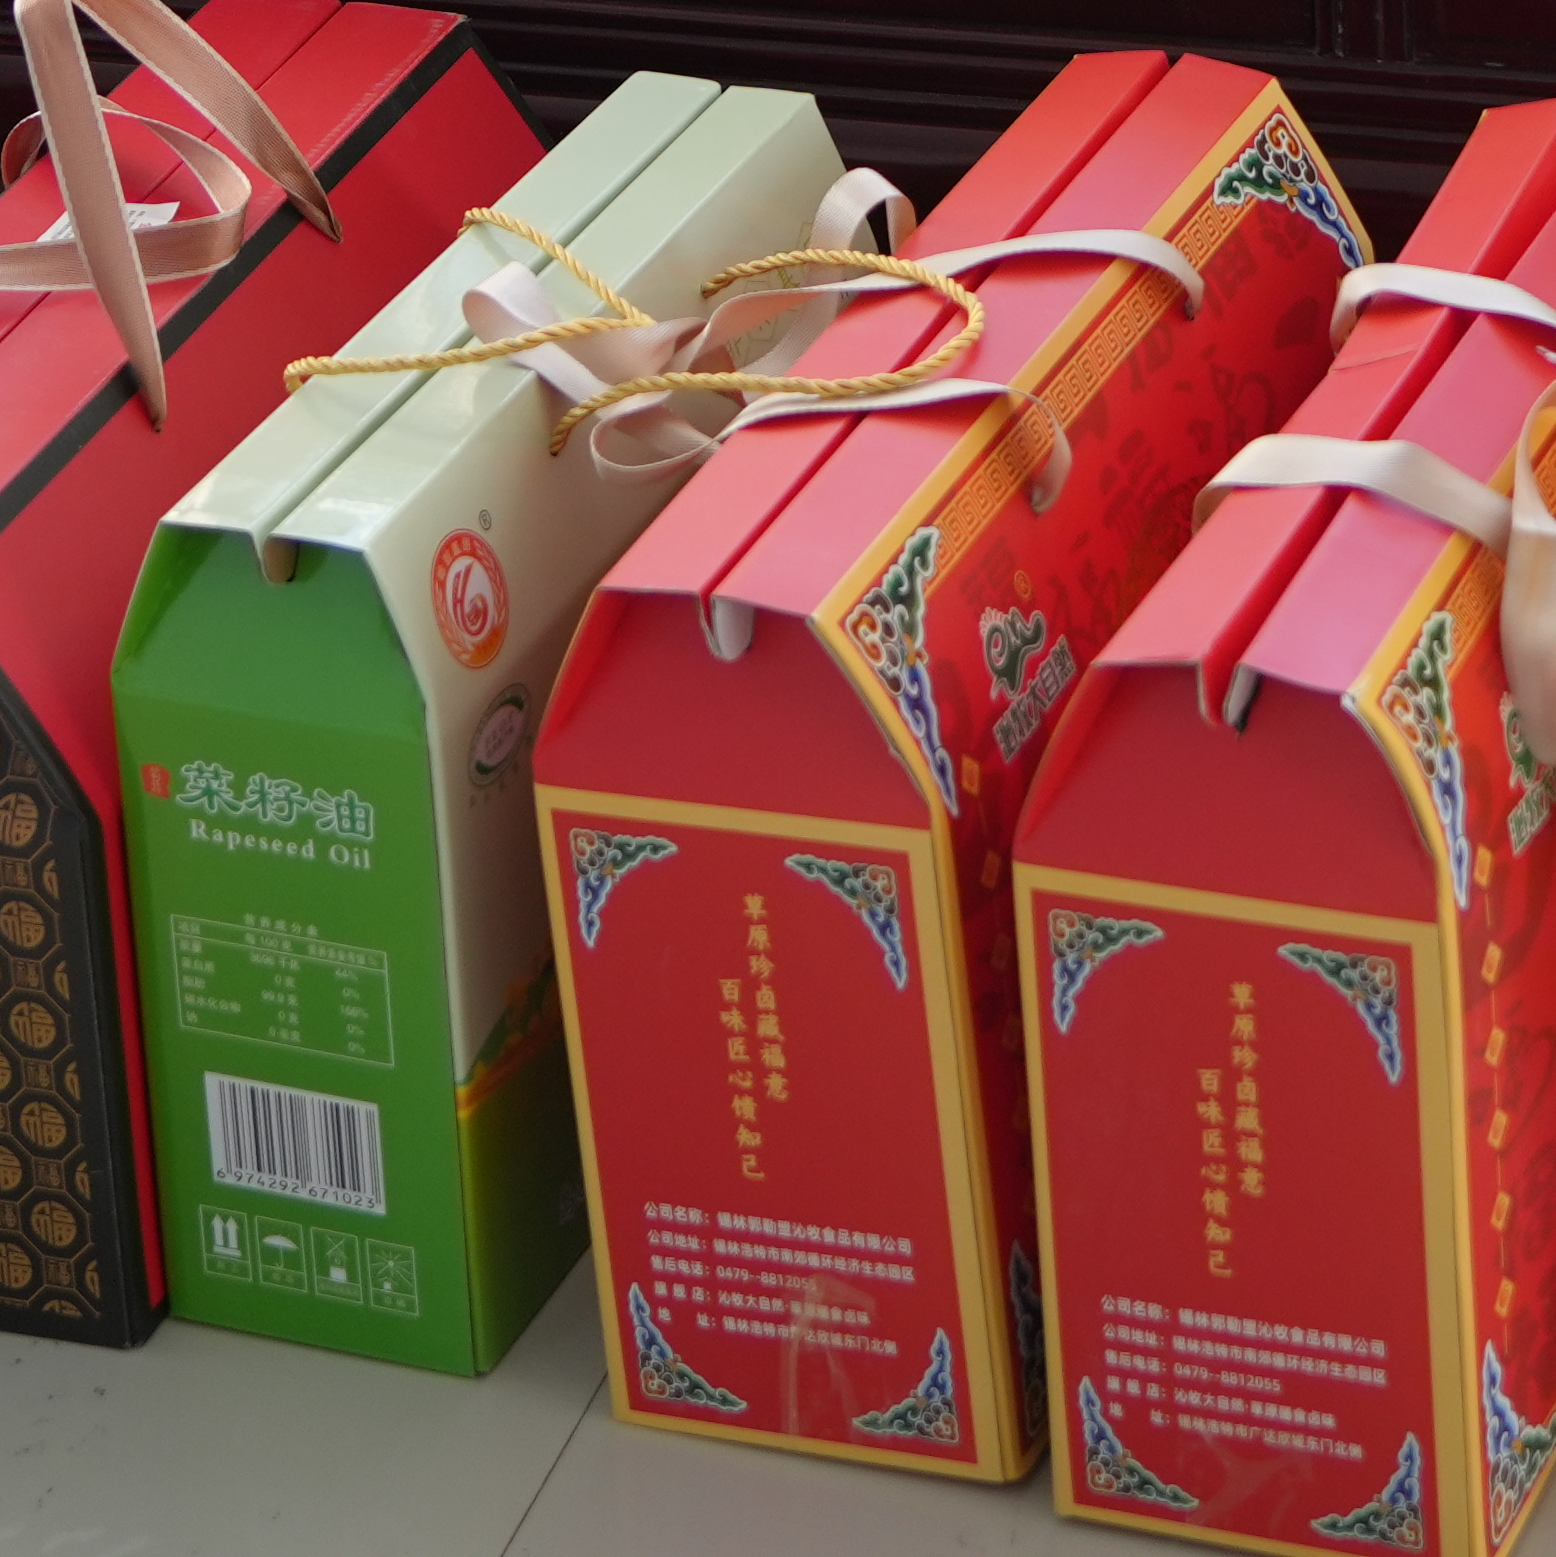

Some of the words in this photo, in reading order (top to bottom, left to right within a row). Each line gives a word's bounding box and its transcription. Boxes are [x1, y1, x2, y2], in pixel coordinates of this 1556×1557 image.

[175, 759, 376, 842] 菜籽油
[189, 818, 316, 860] Rapeseed
[329, 843, 372, 870] Oil
[216, 1167, 227, 1180] 6
[233, 1169, 301, 1194] 974292
[308, 1186, 376, 1210] 671023
